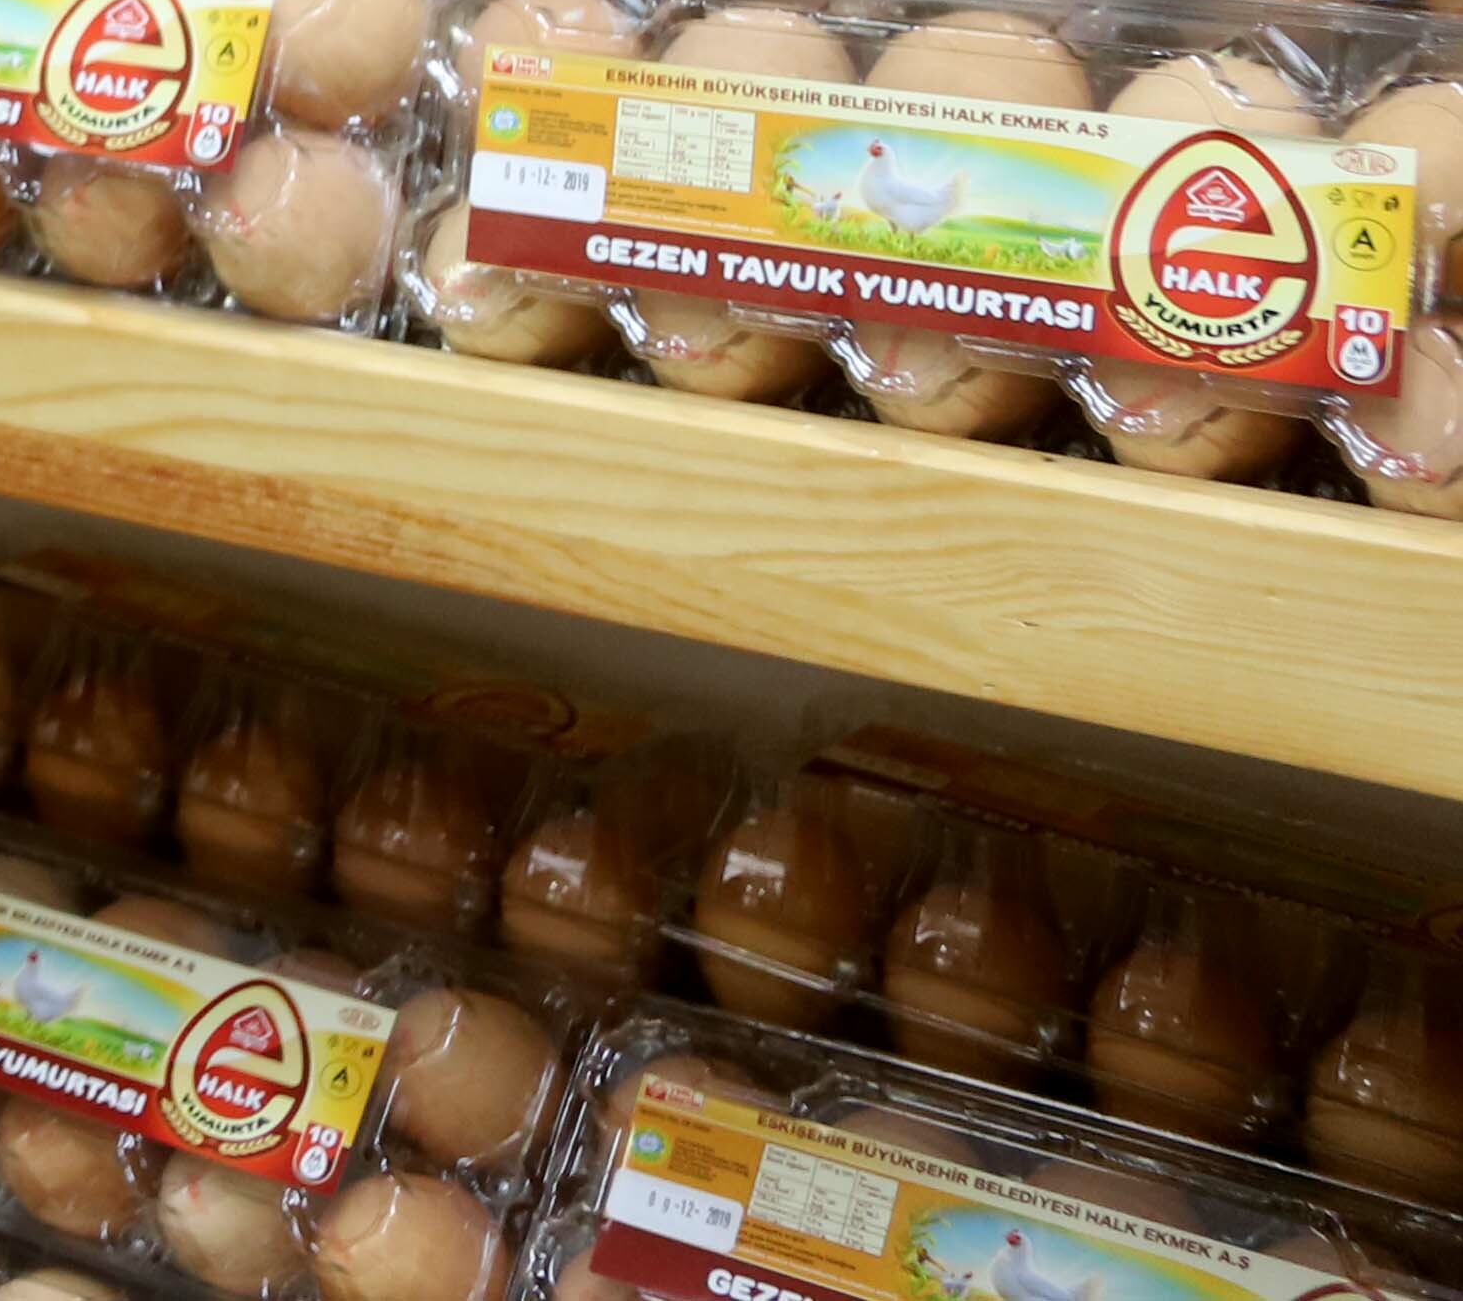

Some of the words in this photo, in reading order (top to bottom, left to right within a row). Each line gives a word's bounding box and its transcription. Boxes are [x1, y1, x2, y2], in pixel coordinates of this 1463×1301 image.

[75, 70, 148, 100] HALK
[606, 69, 698, 92] ESKİŞEHİR
[703, 78, 822, 106] BÜYÜKŞEHİR
[828, 92, 936, 119] BELEDİYESİ
[941, 108, 995, 126] HALK
[1001, 113, 1071, 134] EKMEK
[58, 94, 159, 131] YUMURTA
[198, 105, 230, 126] 10
[563, 170, 589, 191] 2019
[1350, 228, 1377, 252] A
[586, 235, 707, 276] GEZEN
[718, 252, 845, 296] TAVUK
[854, 271, 1095, 331] YUMURTASI
[1161, 263, 1264, 301] HALK
[1142, 293, 1281, 340] YUMURTA
[1339, 309, 1383, 334] 10
[196, 1072, 267, 1113] HALK
[181, 1094, 271, 1136] YUMURTA
[308, 1125, 338, 1145] 10
[757, 1111, 848, 1151] ESKİŞEHİR
[852, 1140, 969, 1185] BÜYÜKŞEHİR
[973, 1176, 1081, 1221] BELEDİYESİ
[1085, 1209, 1138, 1237] HALK
[1143, 1227, 1212, 1258] EKMEK
[707, 1268, 813, 1301] GEZ
